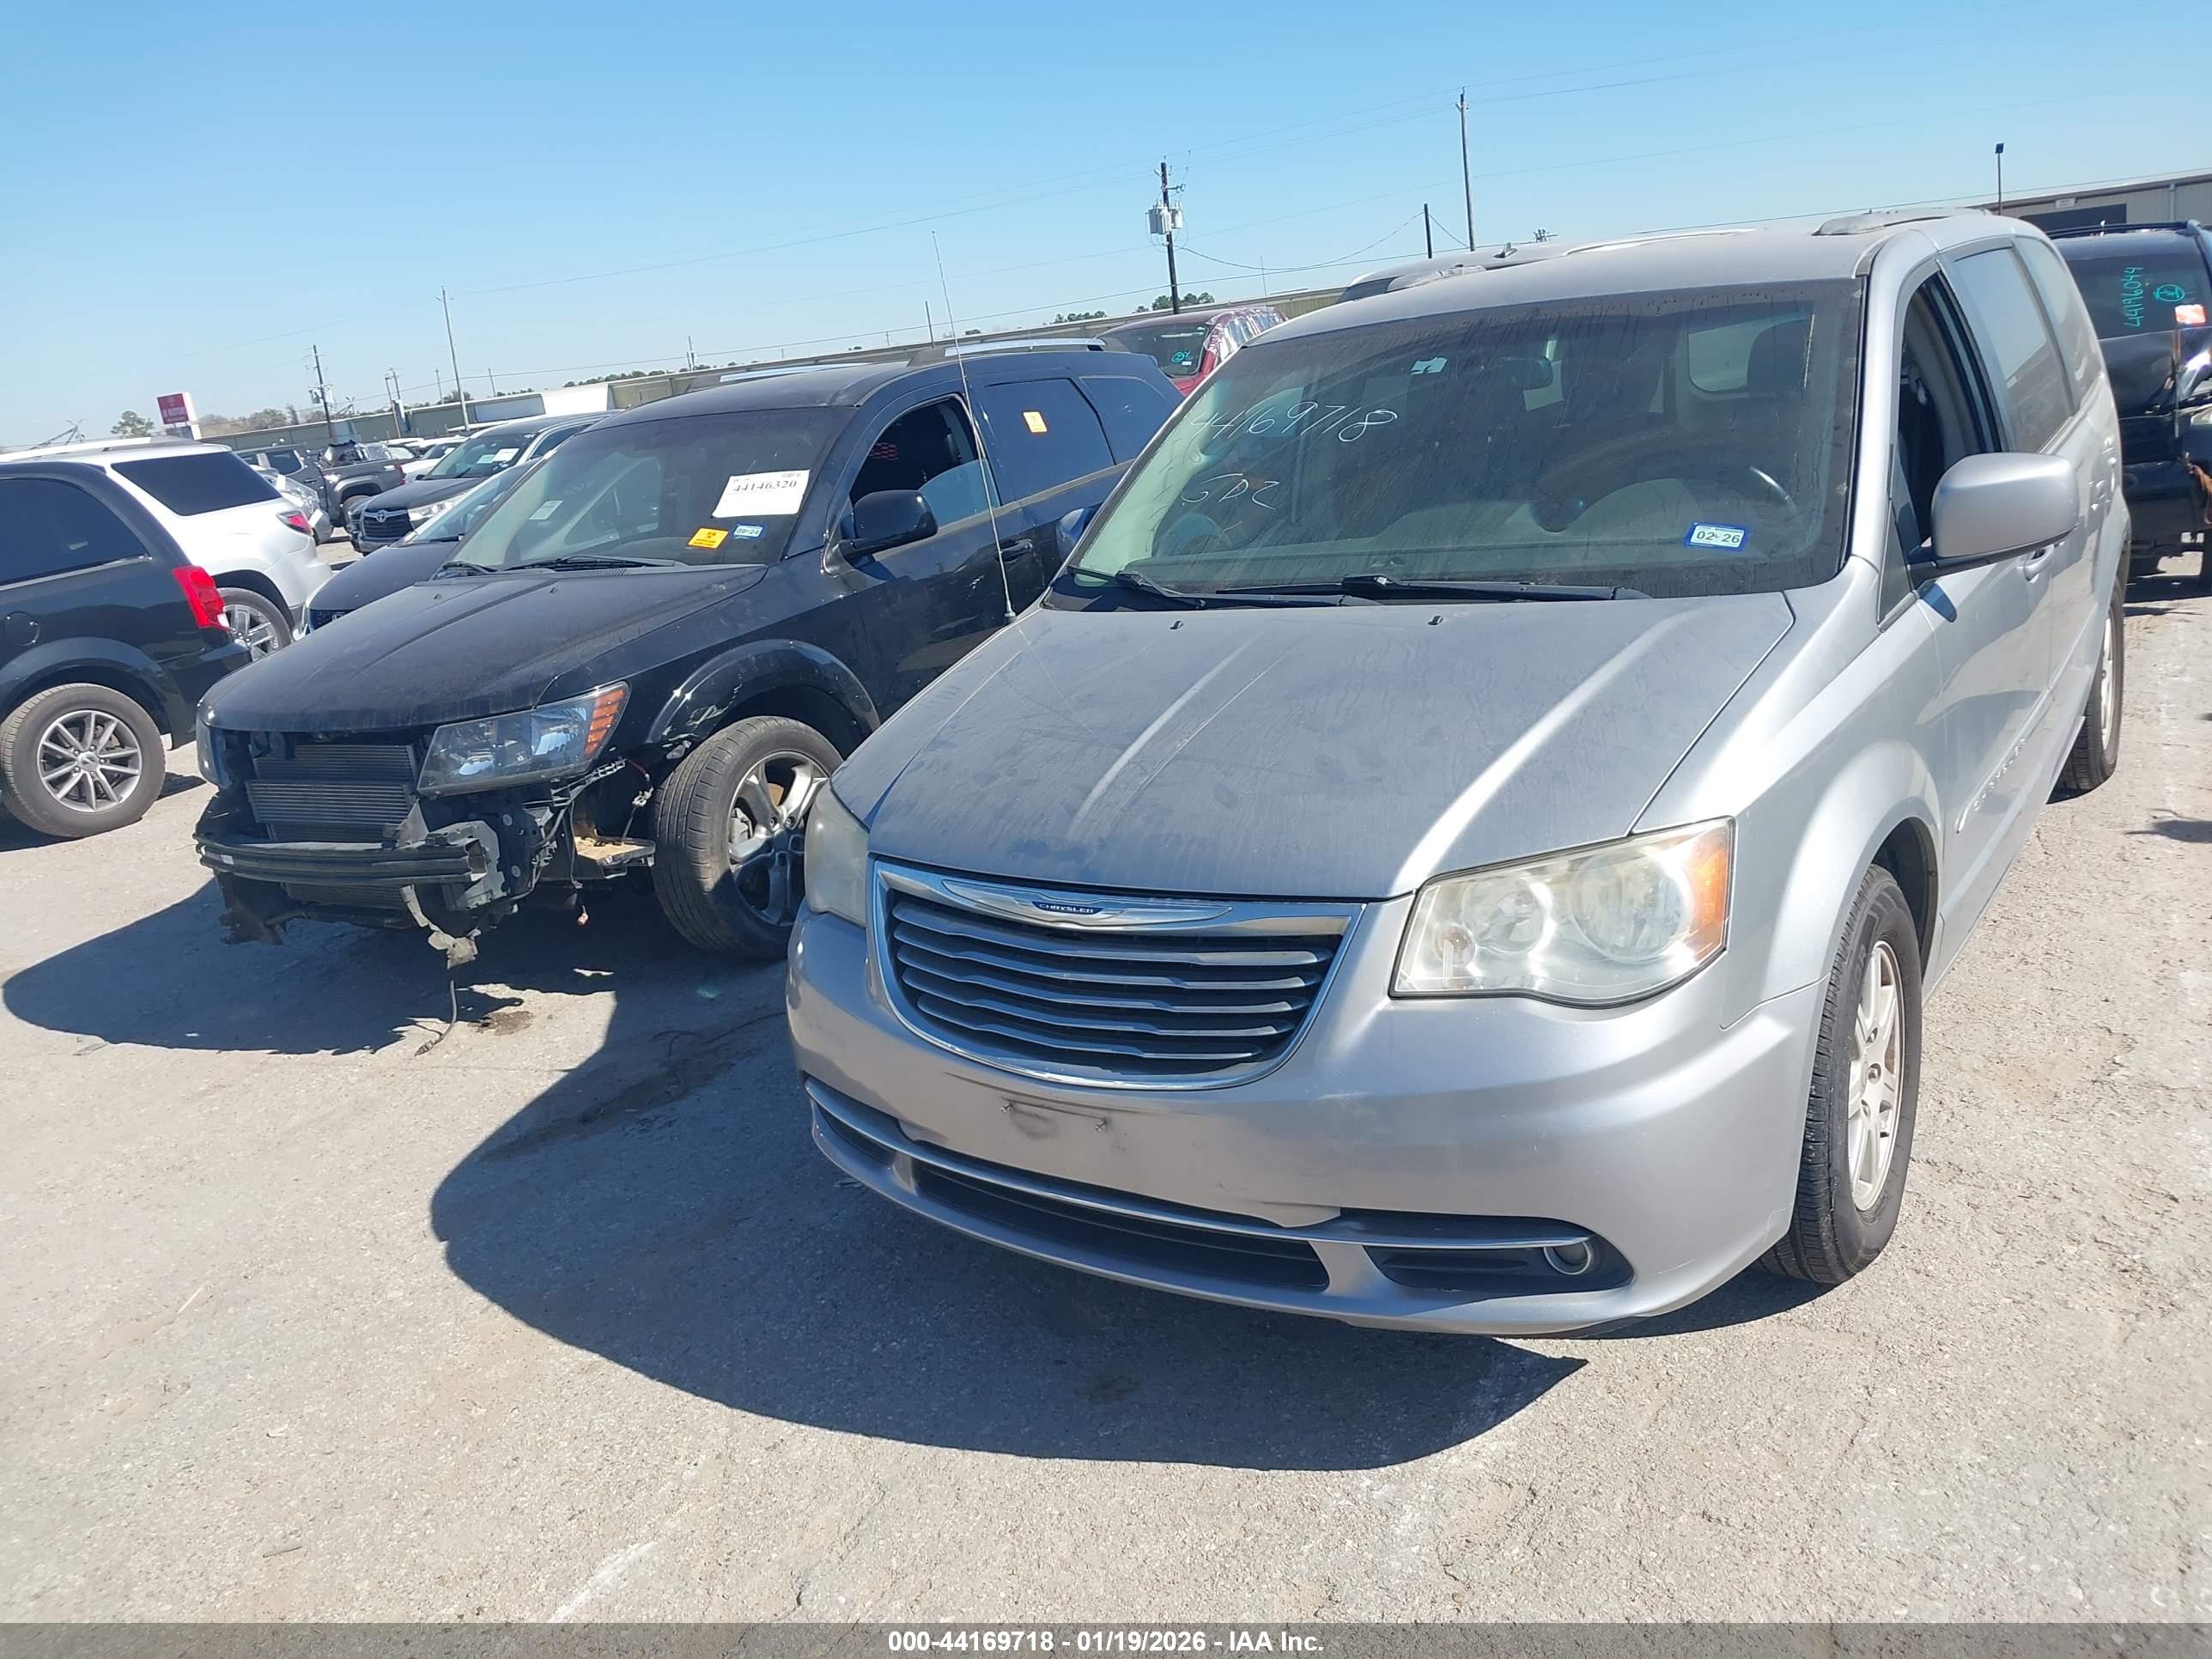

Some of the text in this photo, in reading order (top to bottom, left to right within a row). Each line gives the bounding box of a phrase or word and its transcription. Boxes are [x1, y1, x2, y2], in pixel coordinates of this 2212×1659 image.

[2121, 267, 2144, 326] 44196044
[1190, 401, 1399, 442] 44169718
[732, 480, 798, 492] 44146320
[1722, 533, 1741, 544] 26
[1039, 903, 1094, 913] CHRYSLER
